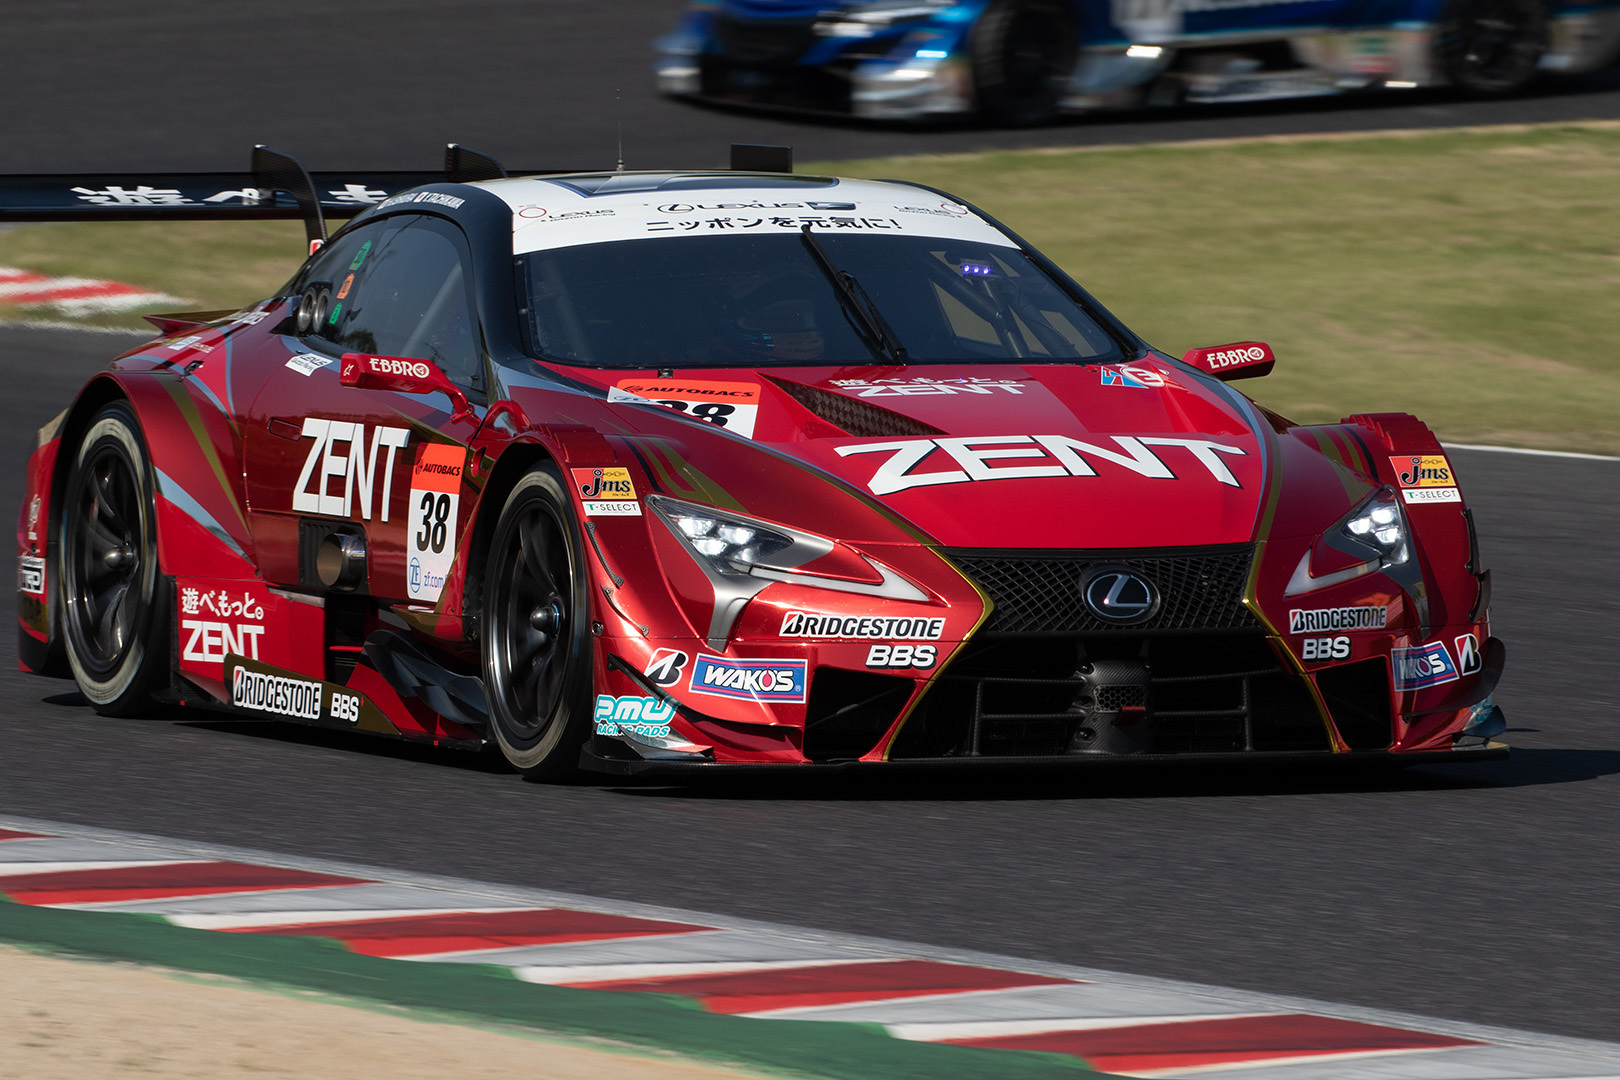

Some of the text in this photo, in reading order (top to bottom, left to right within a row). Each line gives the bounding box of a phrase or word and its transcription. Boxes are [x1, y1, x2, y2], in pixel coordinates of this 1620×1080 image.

[369, 358, 430, 378] EBBRO
[1206, 347, 1265, 370] EBBRO
[644, 386, 754, 398] AUTOBACS
[842, 384, 1026, 397] ZENT
[292, 417, 412, 524] ZENT
[422, 462, 462, 477] AUTOBACS
[833, 434, 1250, 496] ZENT
[586, 503, 637, 511] T-SELECT
[1406, 490, 1456, 499] T-SELECT
[416, 491, 451, 554] 38
[781, 612, 945, 640] BRIDGESTONE
[1290, 606, 1388, 634] BRIDGESTONE
[182, 619, 265, 664] ZENT
[1302, 636, 1351, 661] BBS
[865, 645, 937, 670] BBS
[703, 664, 795, 692] WAKO'S
[232, 665, 323, 720] BRIDGESTONE
[330, 692, 360, 722] BBS
[635, 726, 670, 737] PADS
